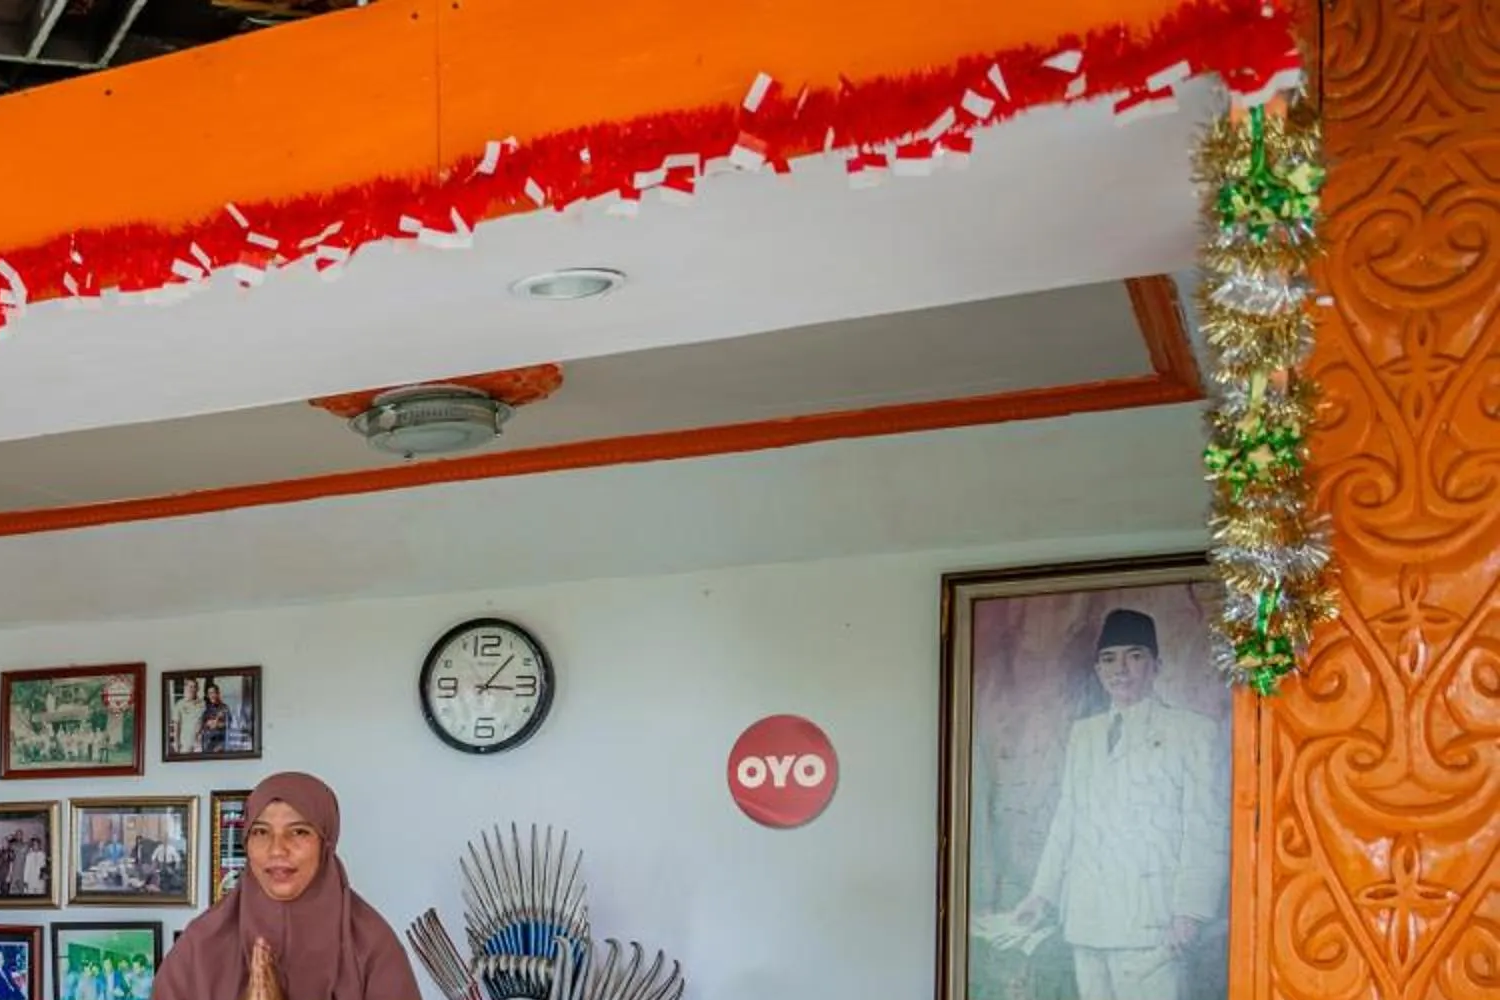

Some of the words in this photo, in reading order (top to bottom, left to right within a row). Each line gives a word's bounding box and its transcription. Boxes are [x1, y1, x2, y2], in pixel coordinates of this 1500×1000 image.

[474, 635, 501, 657] 12
[437, 677, 459, 699] 9
[515, 675, 537, 697] 3
[474, 717, 495, 739] 6
[737, 753, 826, 789] OYO
